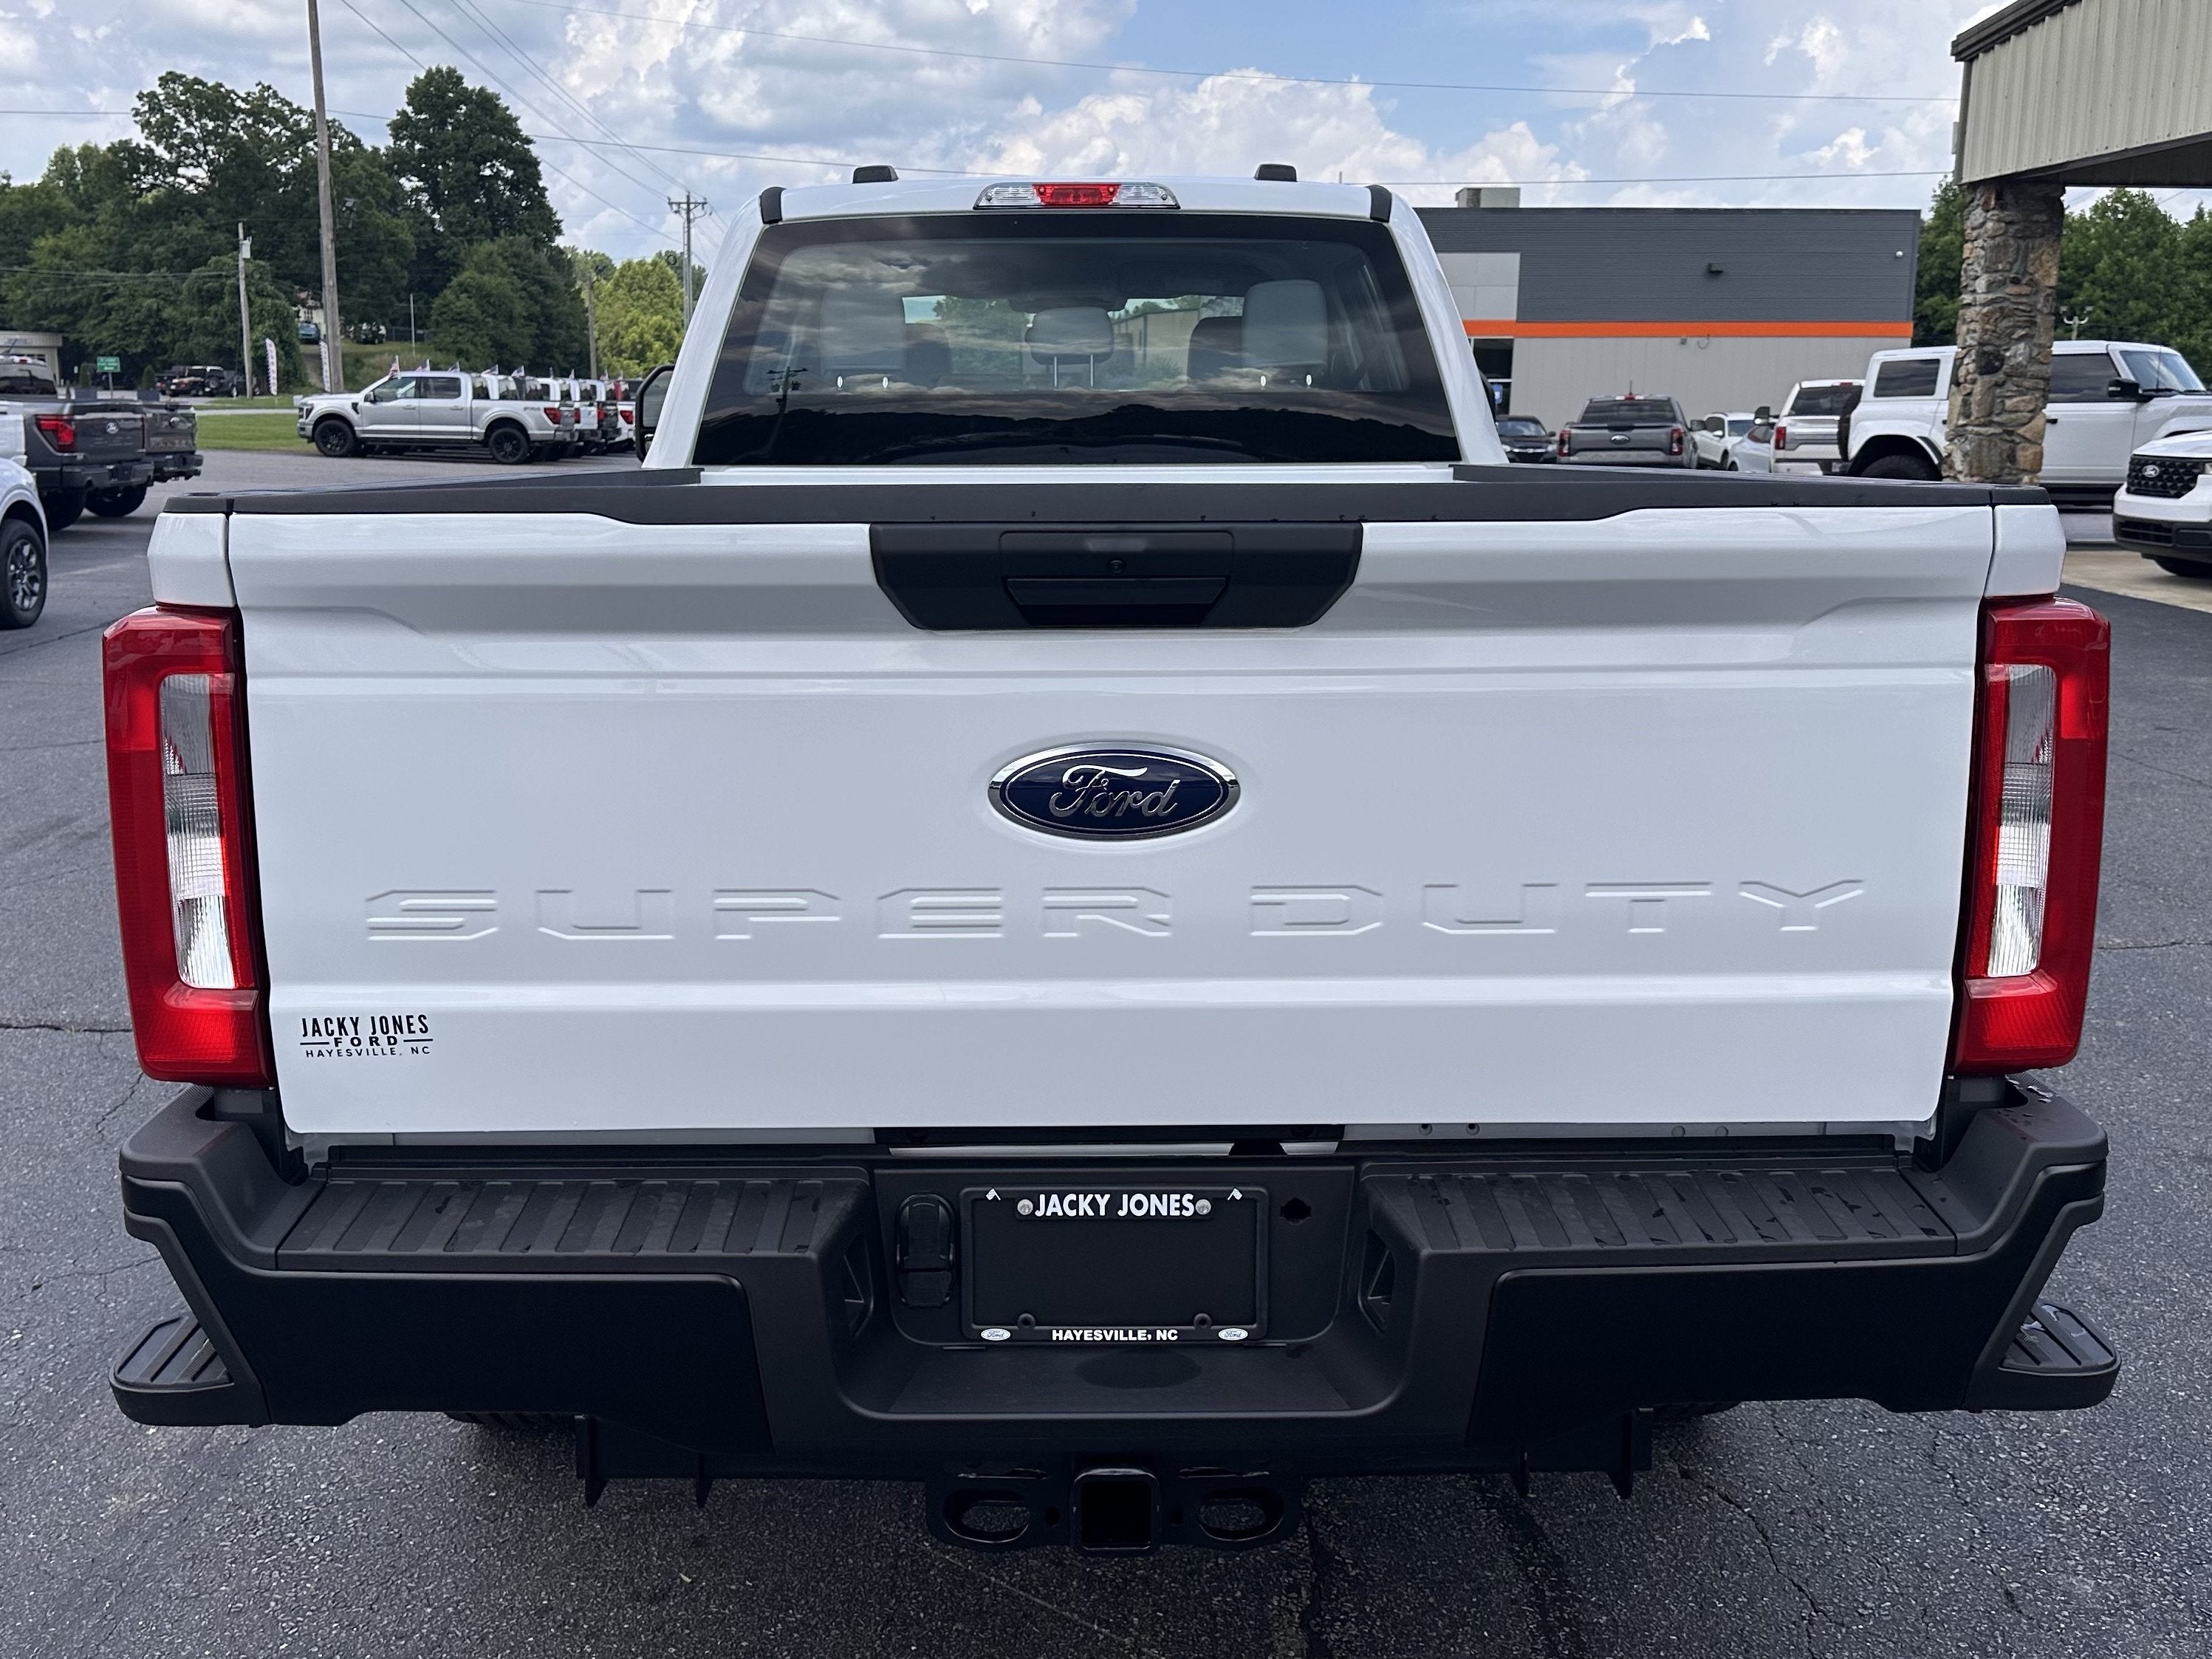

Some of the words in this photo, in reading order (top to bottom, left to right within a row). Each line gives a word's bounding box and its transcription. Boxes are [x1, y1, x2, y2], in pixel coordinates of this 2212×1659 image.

[1049, 764, 1181, 817] Ford
[366, 886, 1171, 941] SUPER
[1250, 879, 1866, 936] DUTY
[302, 1016, 359, 1037] JACKY
[370, 1014, 428, 1035] JONES
[334, 1036, 397, 1047] FORD
[411, 1046, 431, 1055] NC
[1034, 1194, 1111, 1217] JACKY
[1117, 1194, 1195, 1217] JONES
[1052, 1330, 1151, 1341] HAYESVILLE,
[1156, 1330, 1178, 1341] NC
